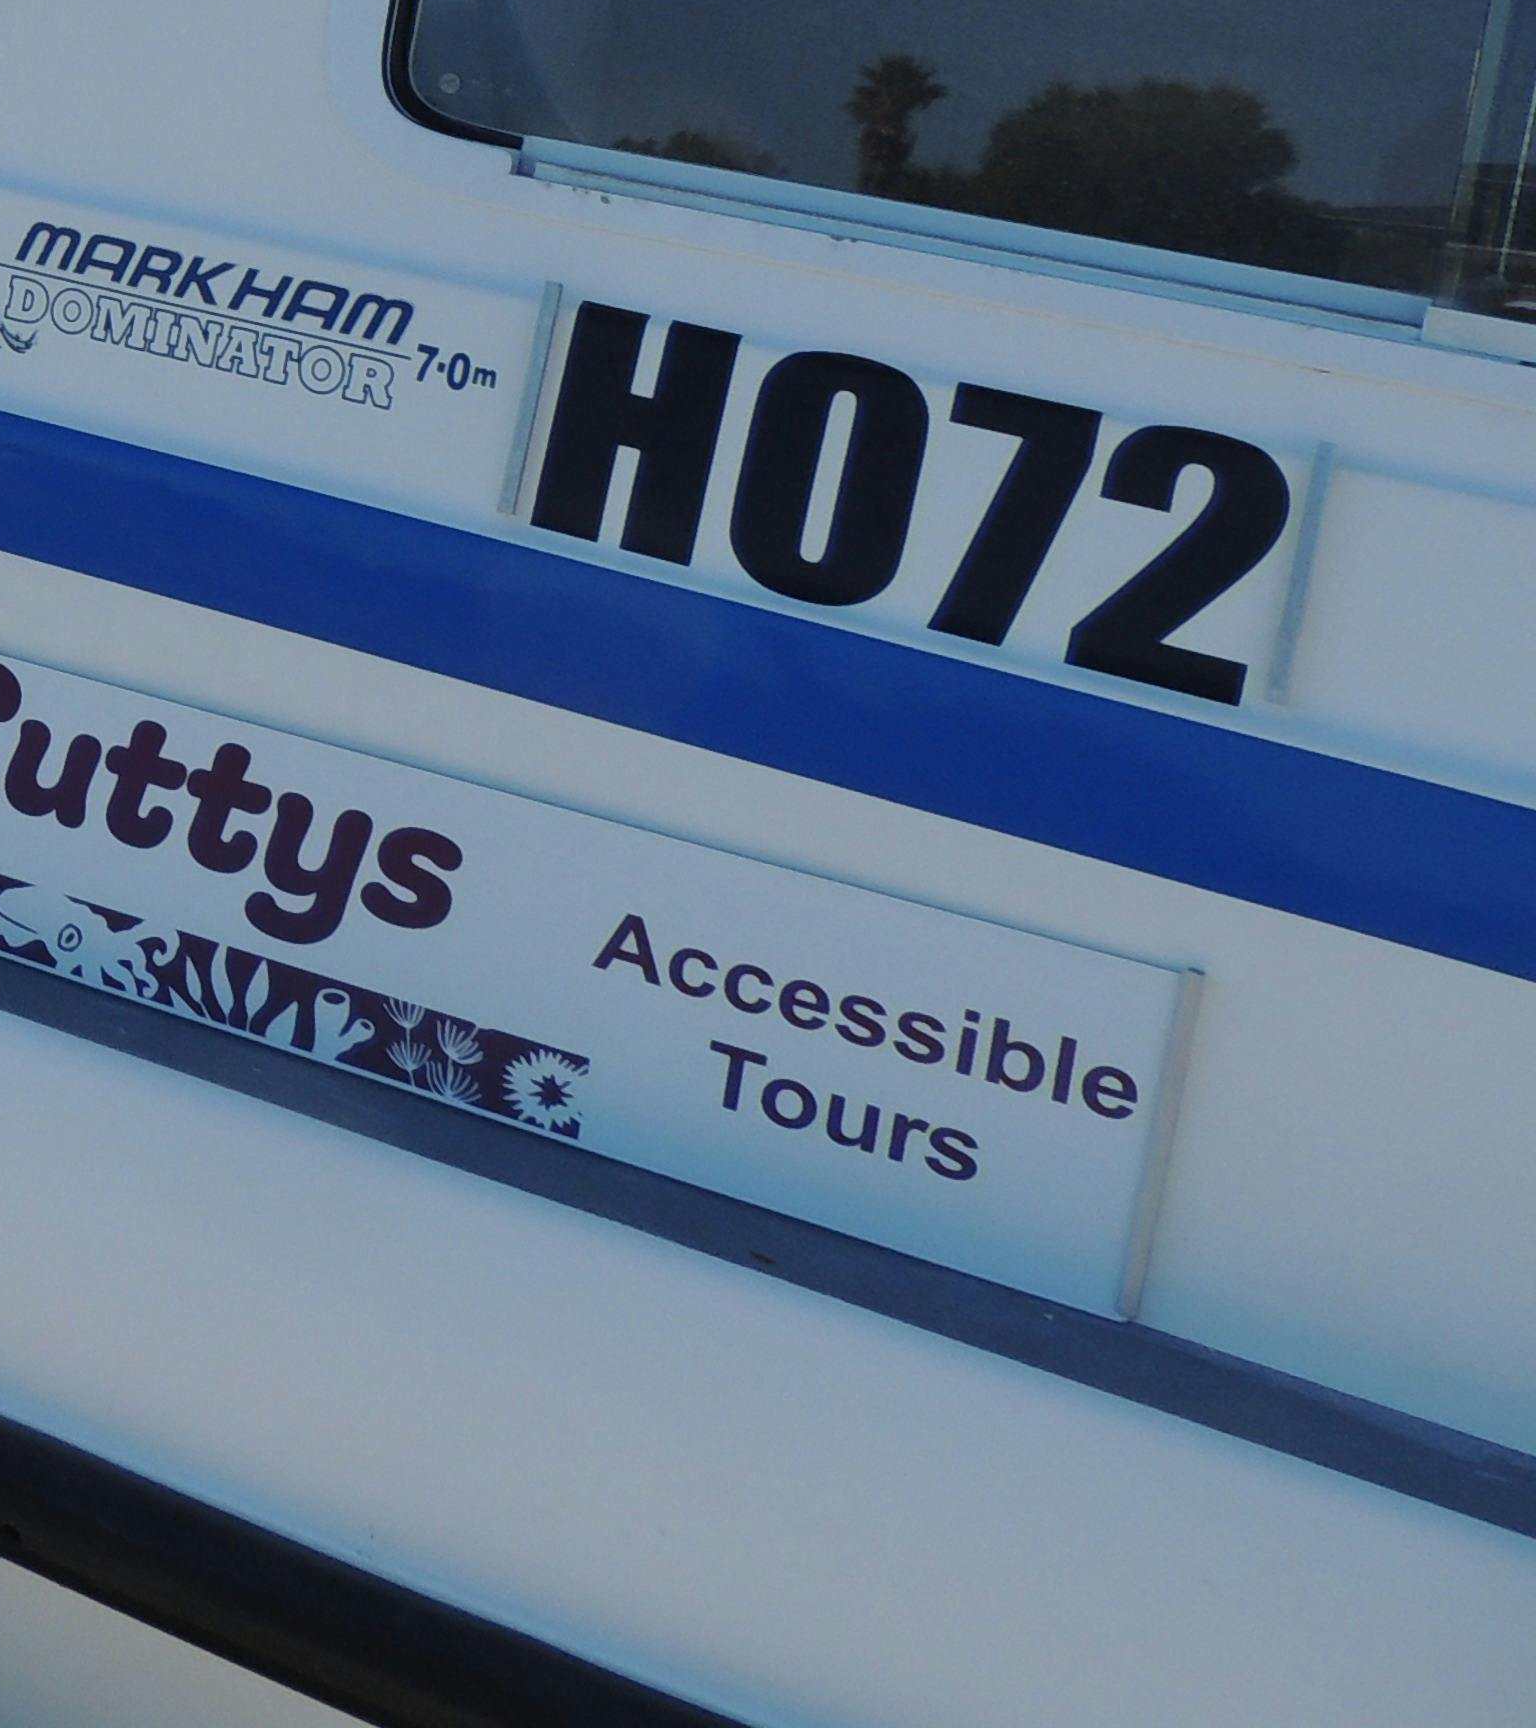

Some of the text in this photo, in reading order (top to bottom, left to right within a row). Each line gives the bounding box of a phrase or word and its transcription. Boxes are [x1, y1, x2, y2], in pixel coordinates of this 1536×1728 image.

[4, 274, 394, 410] DOMINATOR
[15, 221, 414, 346] MARKHAM
[592, 913, 1139, 1120] Accessible
[709, 1040, 978, 1181] Tours
